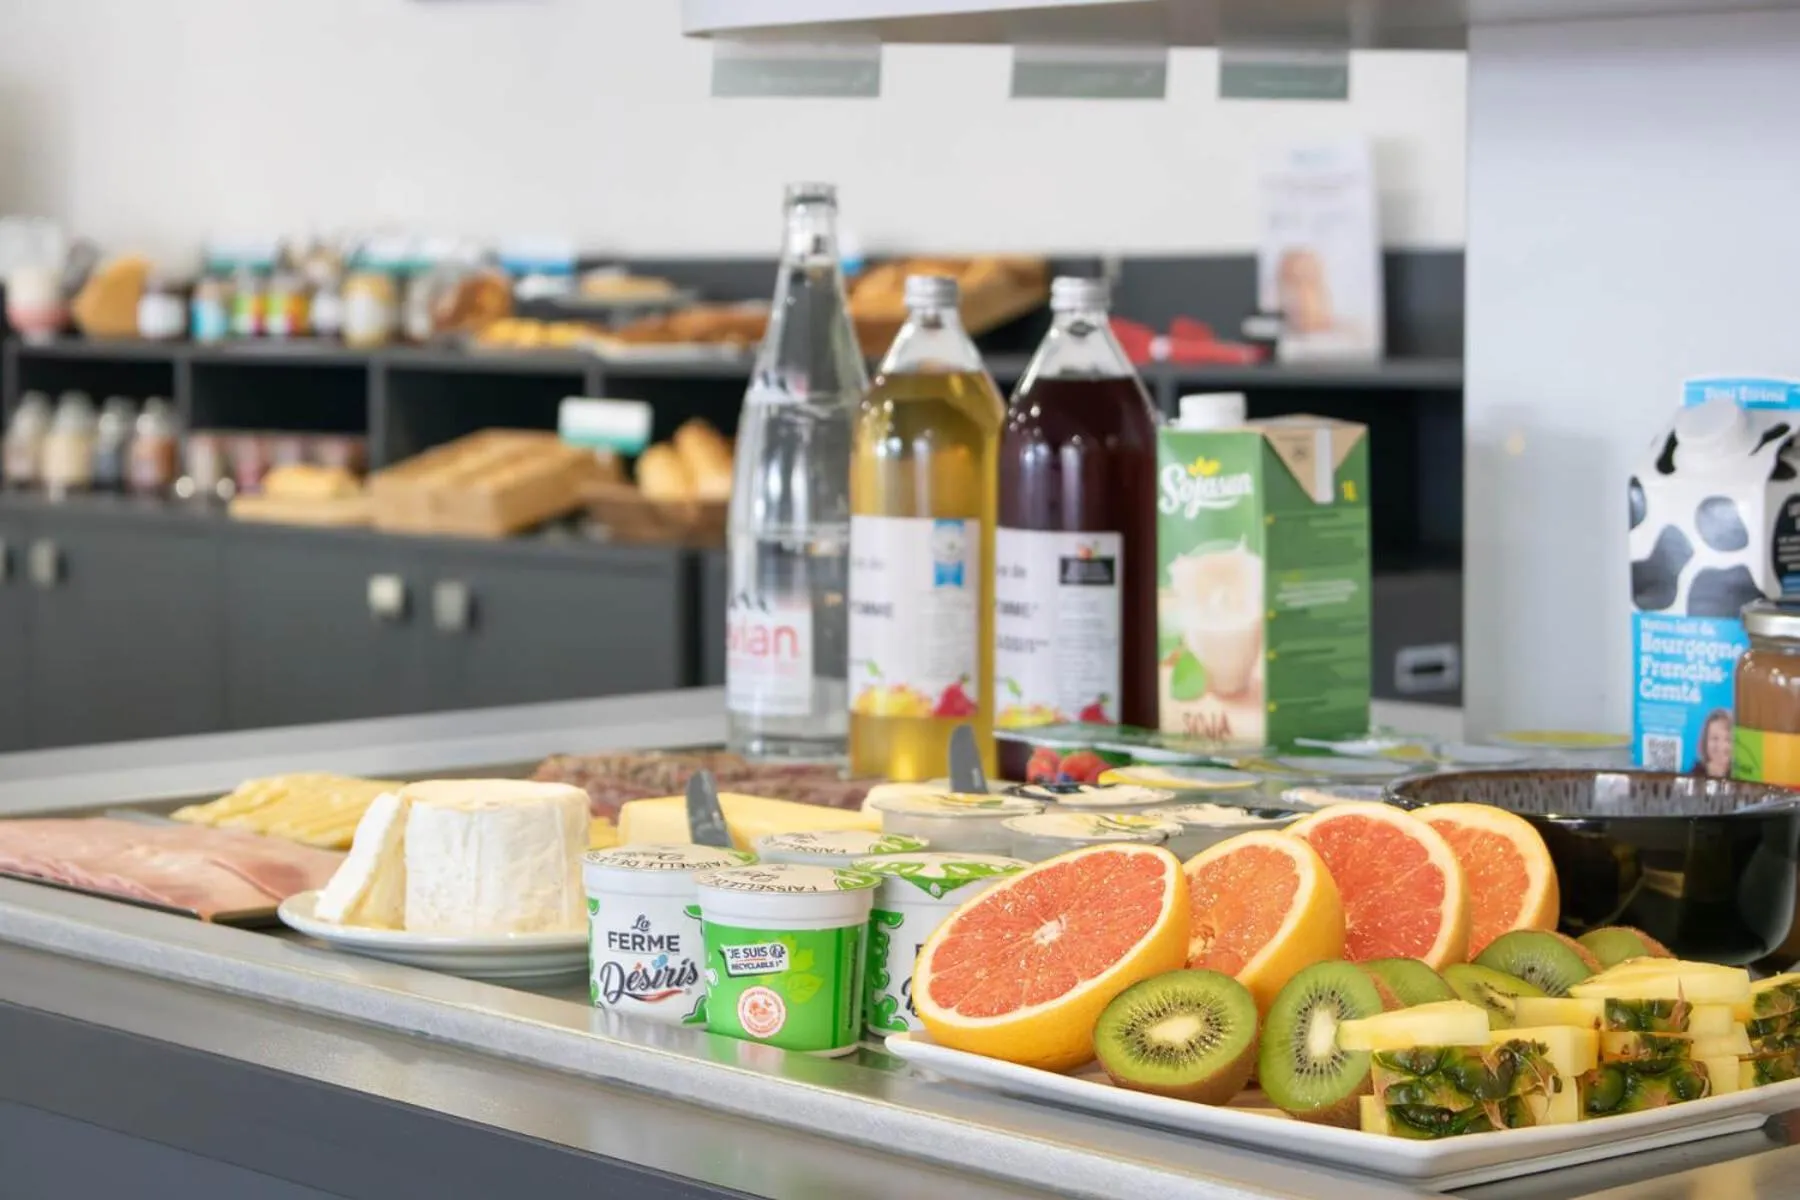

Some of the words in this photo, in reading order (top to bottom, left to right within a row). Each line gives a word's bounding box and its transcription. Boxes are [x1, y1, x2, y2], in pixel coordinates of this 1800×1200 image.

[631, 914, 651, 932] La
[607, 931, 680, 952] FERME
[743, 946, 768, 958] SUIS
[731, 961, 774, 970] RECYCLABLE
